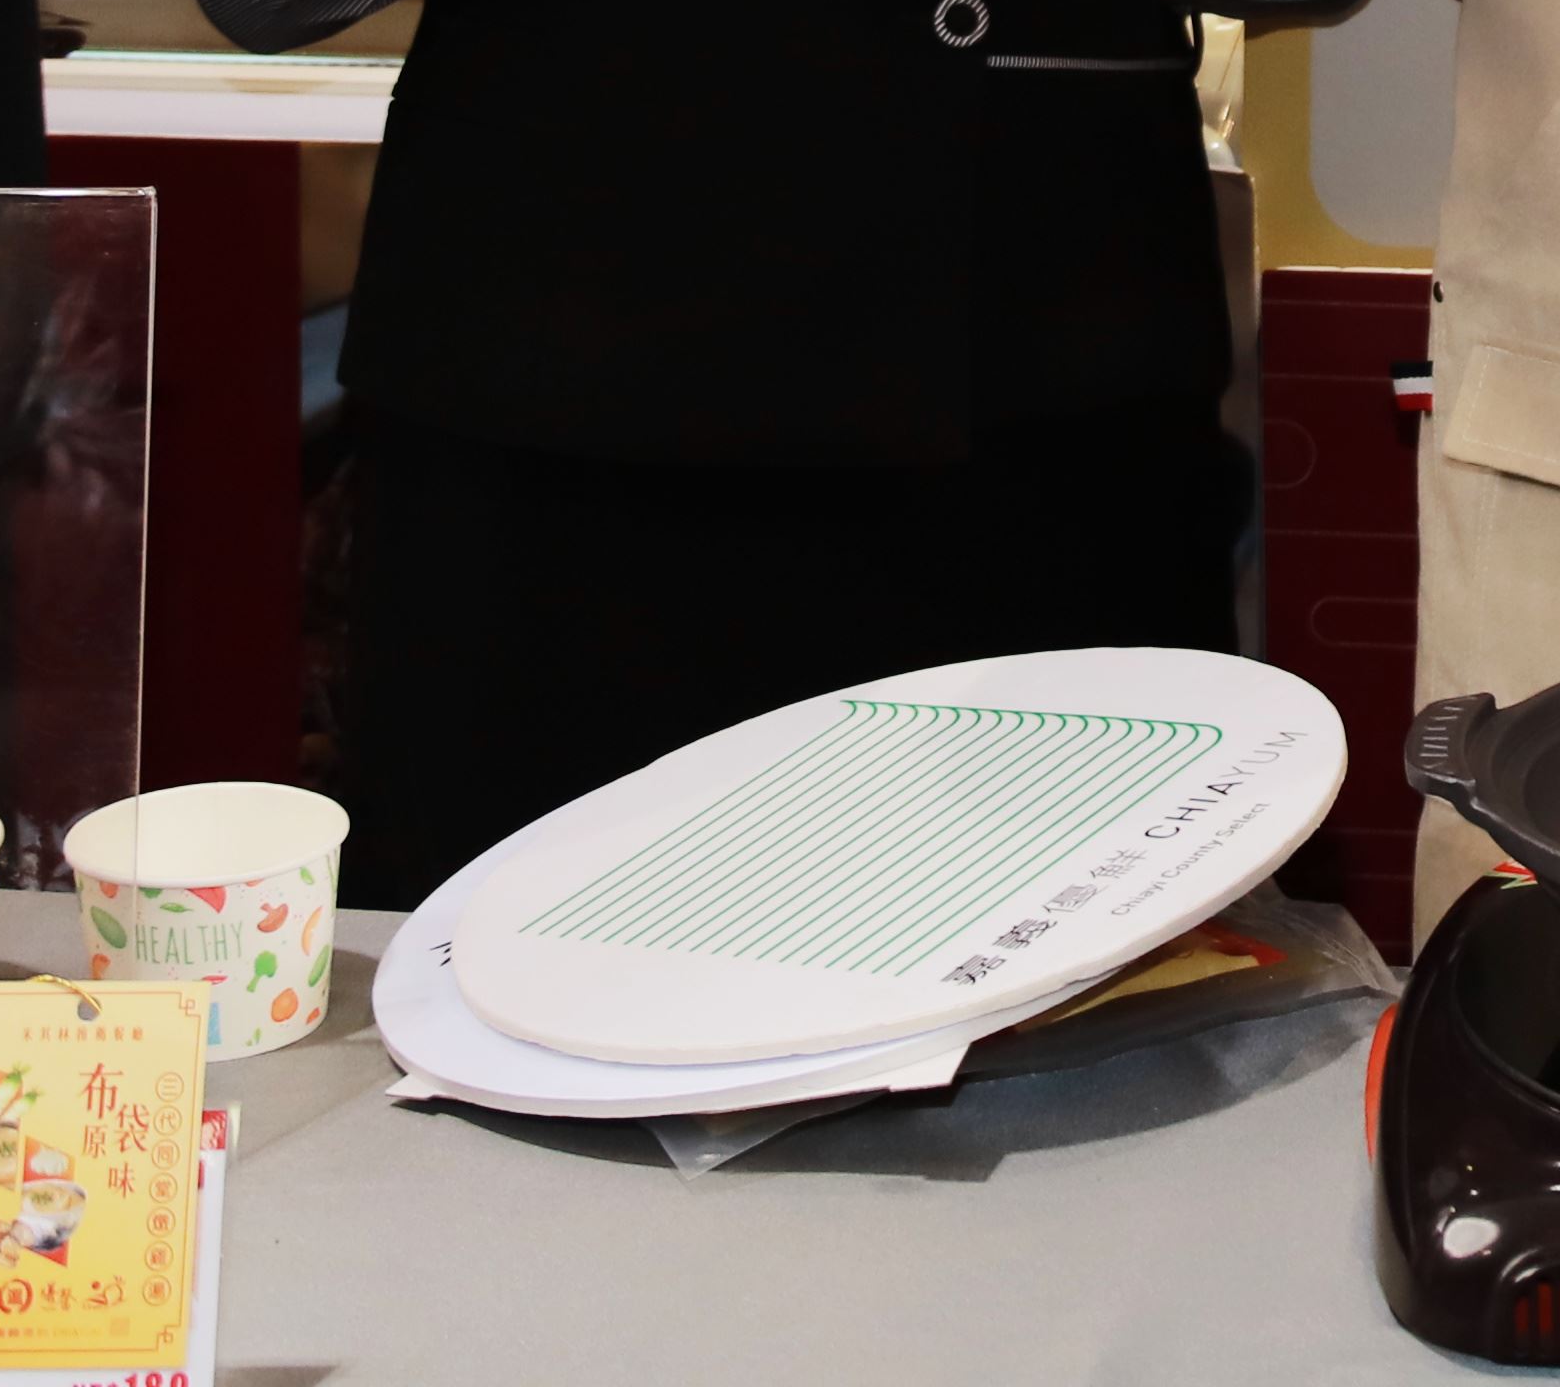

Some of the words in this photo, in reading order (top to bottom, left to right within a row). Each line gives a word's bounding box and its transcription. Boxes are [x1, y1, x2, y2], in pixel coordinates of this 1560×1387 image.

[940, 846, 1149, 986] 嘉義優鮮
[1144, 730, 1309, 841] CHIAYUM
[1164, 837, 1224, 880] County
[1216, 800, 1271, 838] Select
[135, 919, 243, 965] HEALTHY
